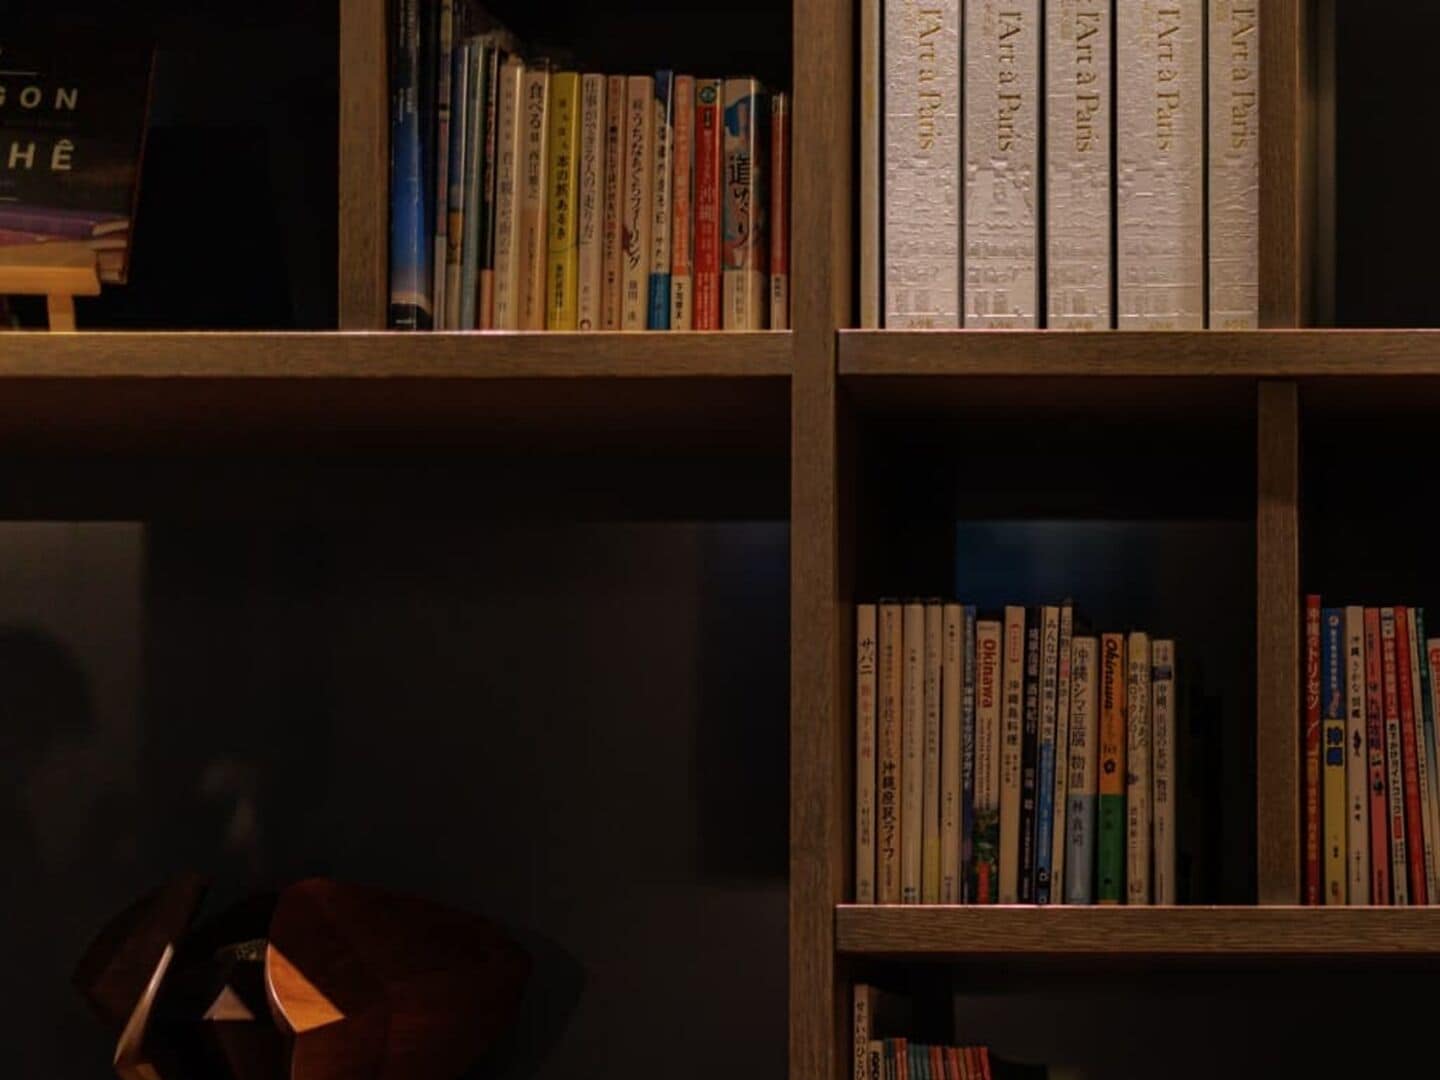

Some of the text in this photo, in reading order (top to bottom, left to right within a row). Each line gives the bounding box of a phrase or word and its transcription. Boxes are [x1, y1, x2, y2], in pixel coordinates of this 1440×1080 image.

[919, 92, 942, 149] Paris
[999, 94, 1022, 151] Paris
[1077, 95, 1100, 152] Paris
[1157, 91, 1180, 150] Paris
[1231, 91, 1256, 149] Paris
[982, 639, 997, 708] Okinawa
[1104, 638, 1121, 709] Okinawa
